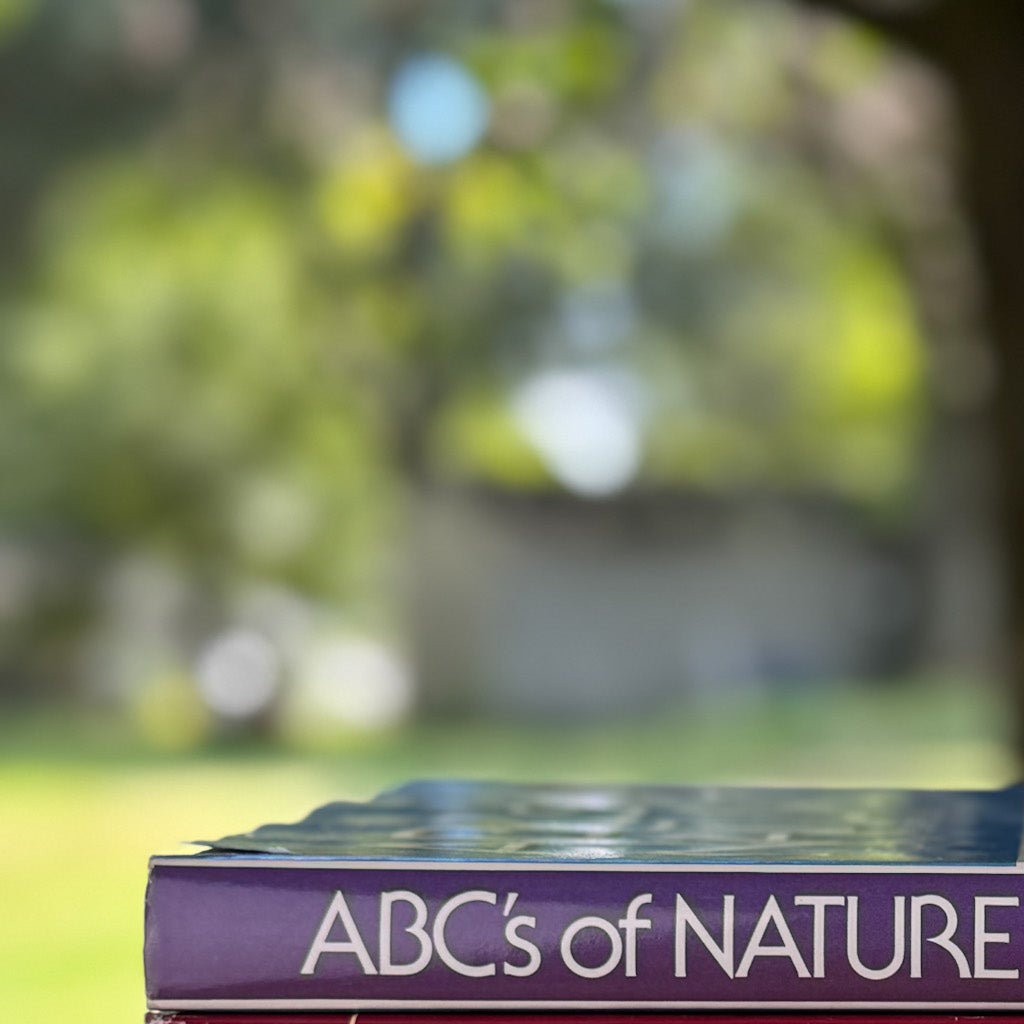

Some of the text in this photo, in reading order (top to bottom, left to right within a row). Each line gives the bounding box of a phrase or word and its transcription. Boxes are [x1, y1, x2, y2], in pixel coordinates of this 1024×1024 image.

[300, 889, 1020, 981] ABC's of NATURE
